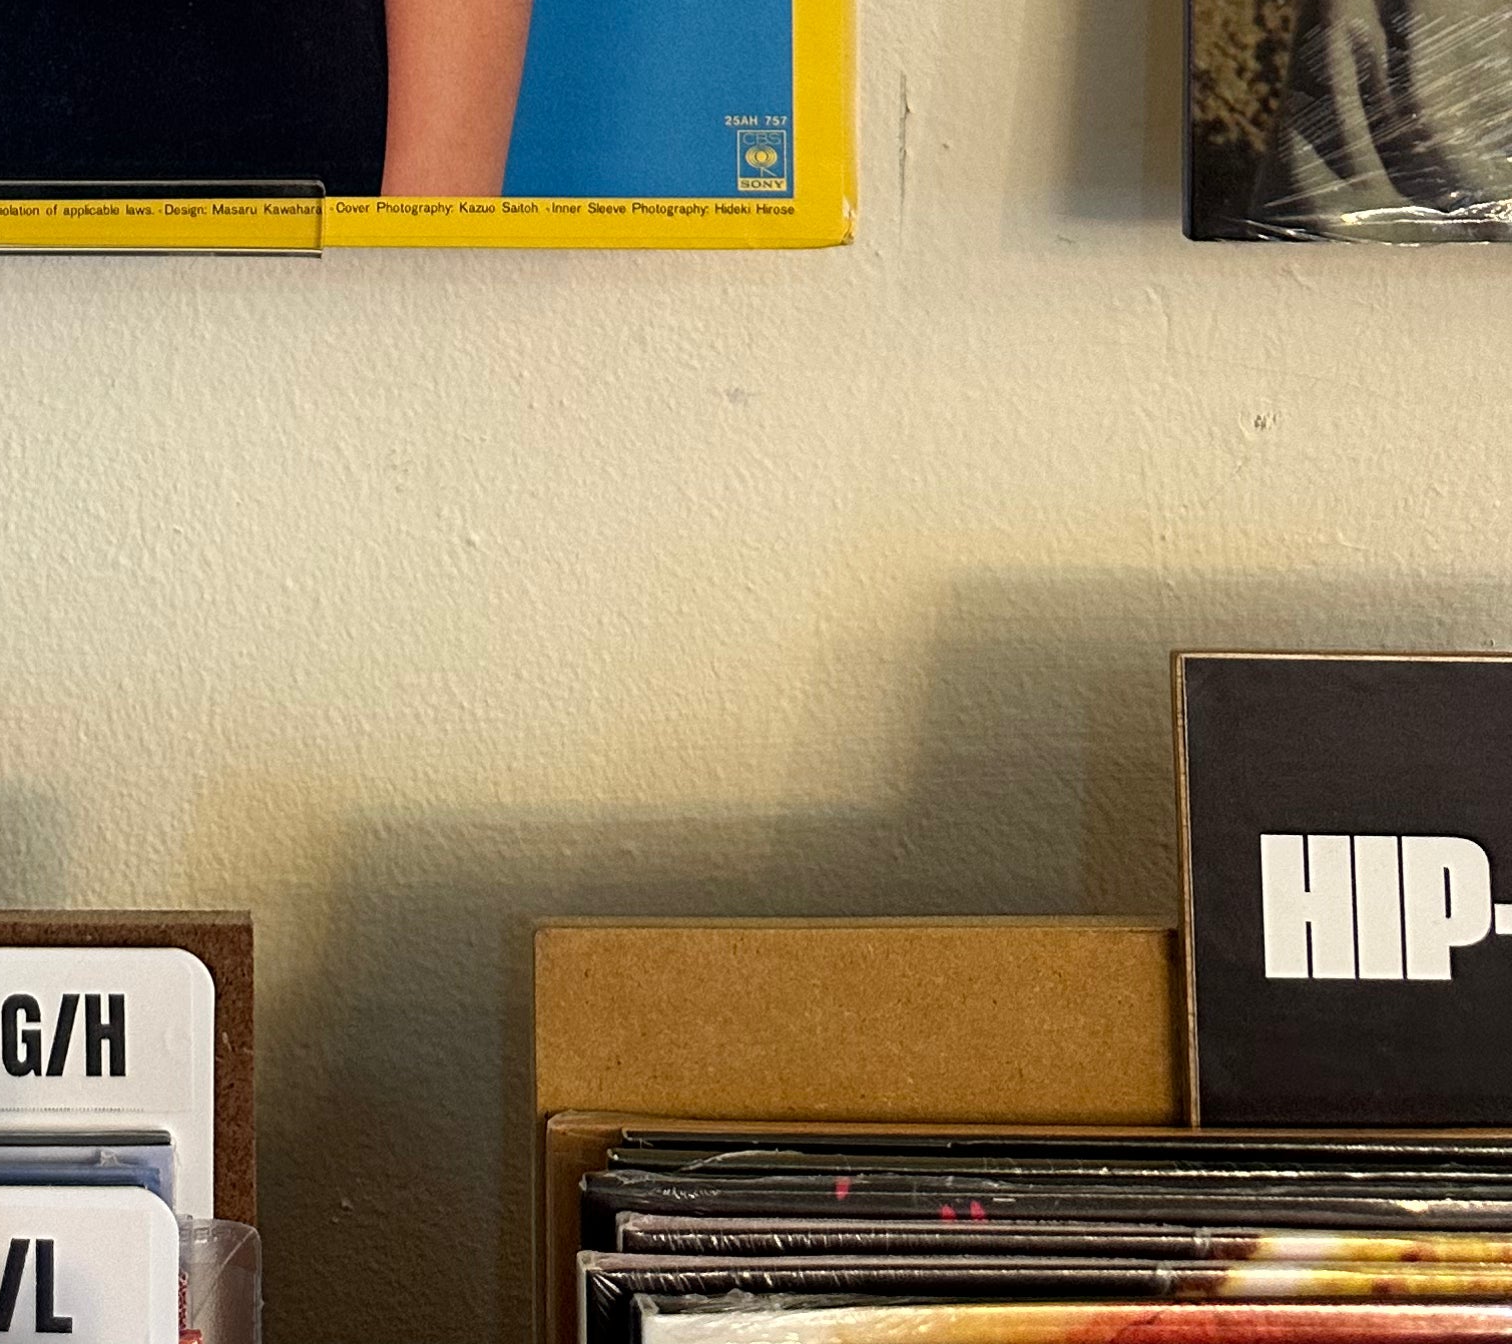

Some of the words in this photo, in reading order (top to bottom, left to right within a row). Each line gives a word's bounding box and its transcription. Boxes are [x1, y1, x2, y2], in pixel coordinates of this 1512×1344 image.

[742, 132, 782, 145] CBS
[740, 179, 785, 189] SONY
[45, 203, 58, 217] of
[62, 204, 120, 219] applicable
[212, 203, 258, 216] Masaru
[263, 203, 323, 216] Kawahara
[335, 201, 370, 214] Cover
[459, 201, 496, 214] Kazuo
[501, 201, 539, 214] Saitoh
[551, 202, 582, 215] Inner
[587, 201, 627, 215] Sleeve
[714, 203, 752, 215] Hideki
[755, 203, 795, 216] Hirose
[1, 993, 127, 1078] G/H
